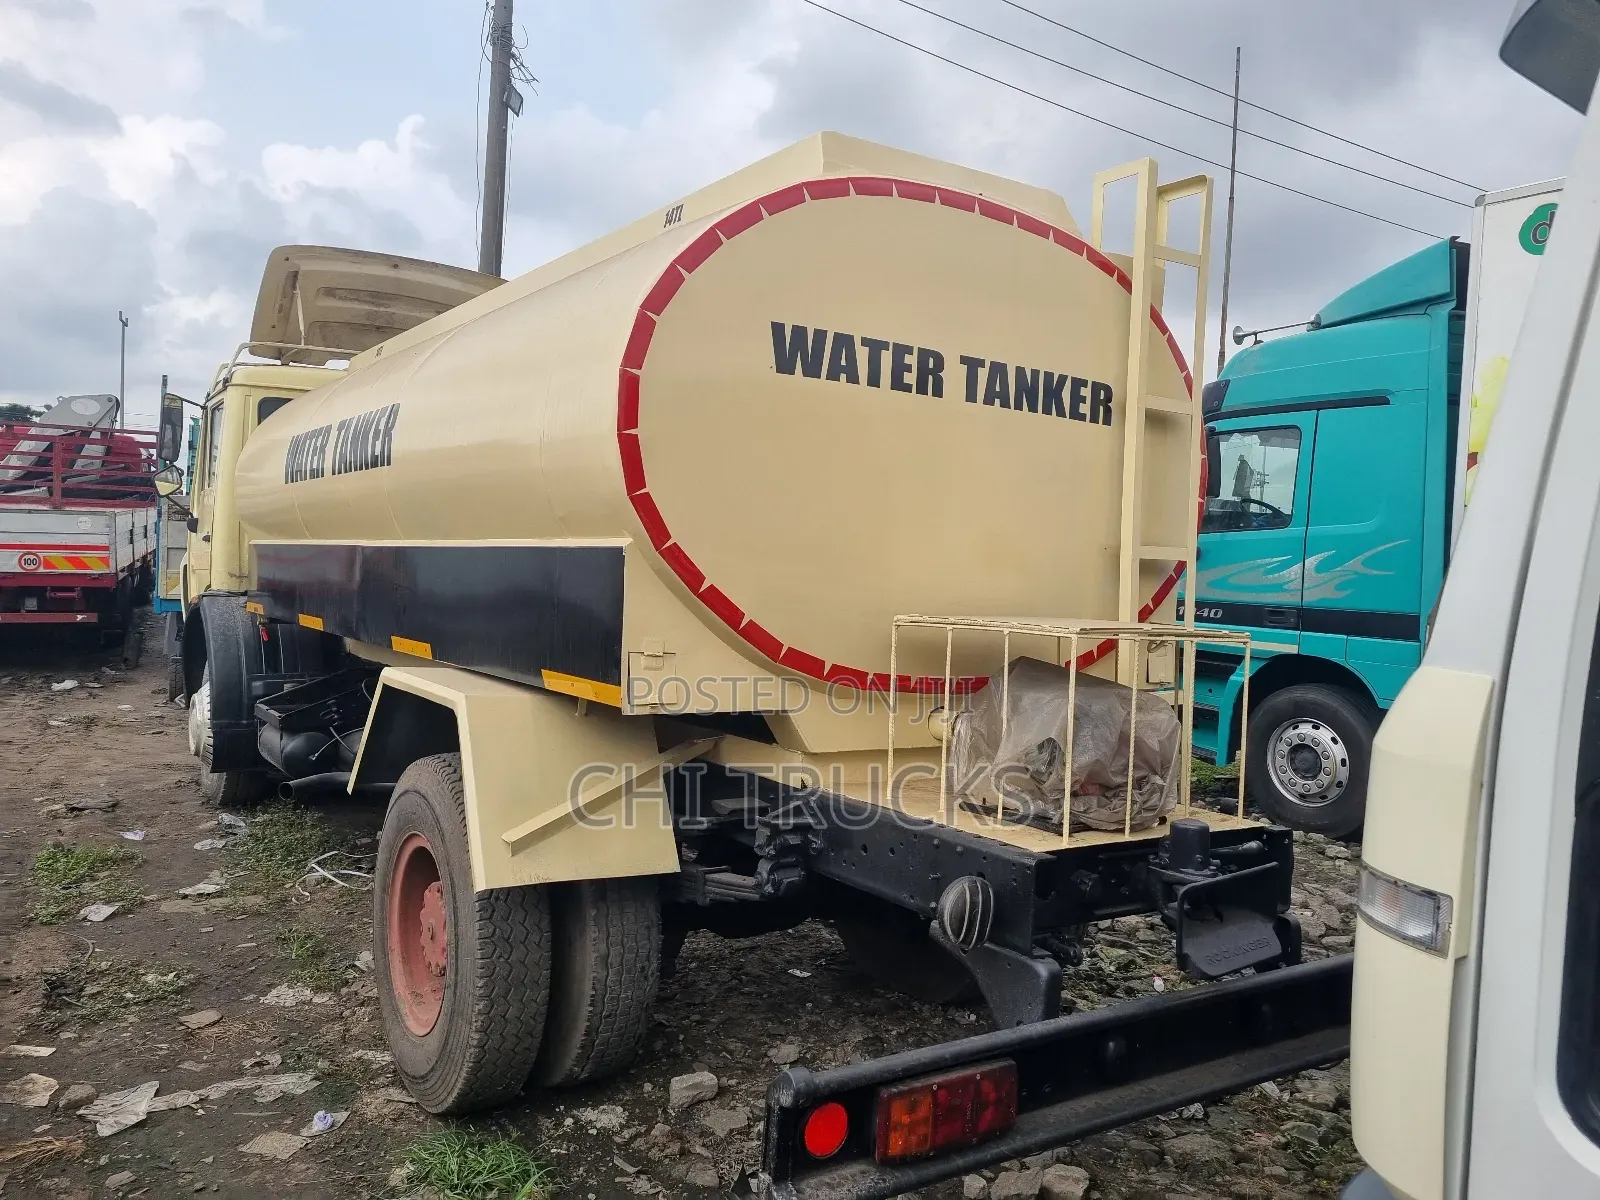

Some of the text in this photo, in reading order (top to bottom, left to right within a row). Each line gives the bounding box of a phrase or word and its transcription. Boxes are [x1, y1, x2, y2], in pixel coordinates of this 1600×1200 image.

[770, 320, 1114, 427] WATER TANKER
[284, 402, 401, 485] WATER TANKER
[22, 557, 38, 566] 100
[1177, 605, 1224, 619] 140
